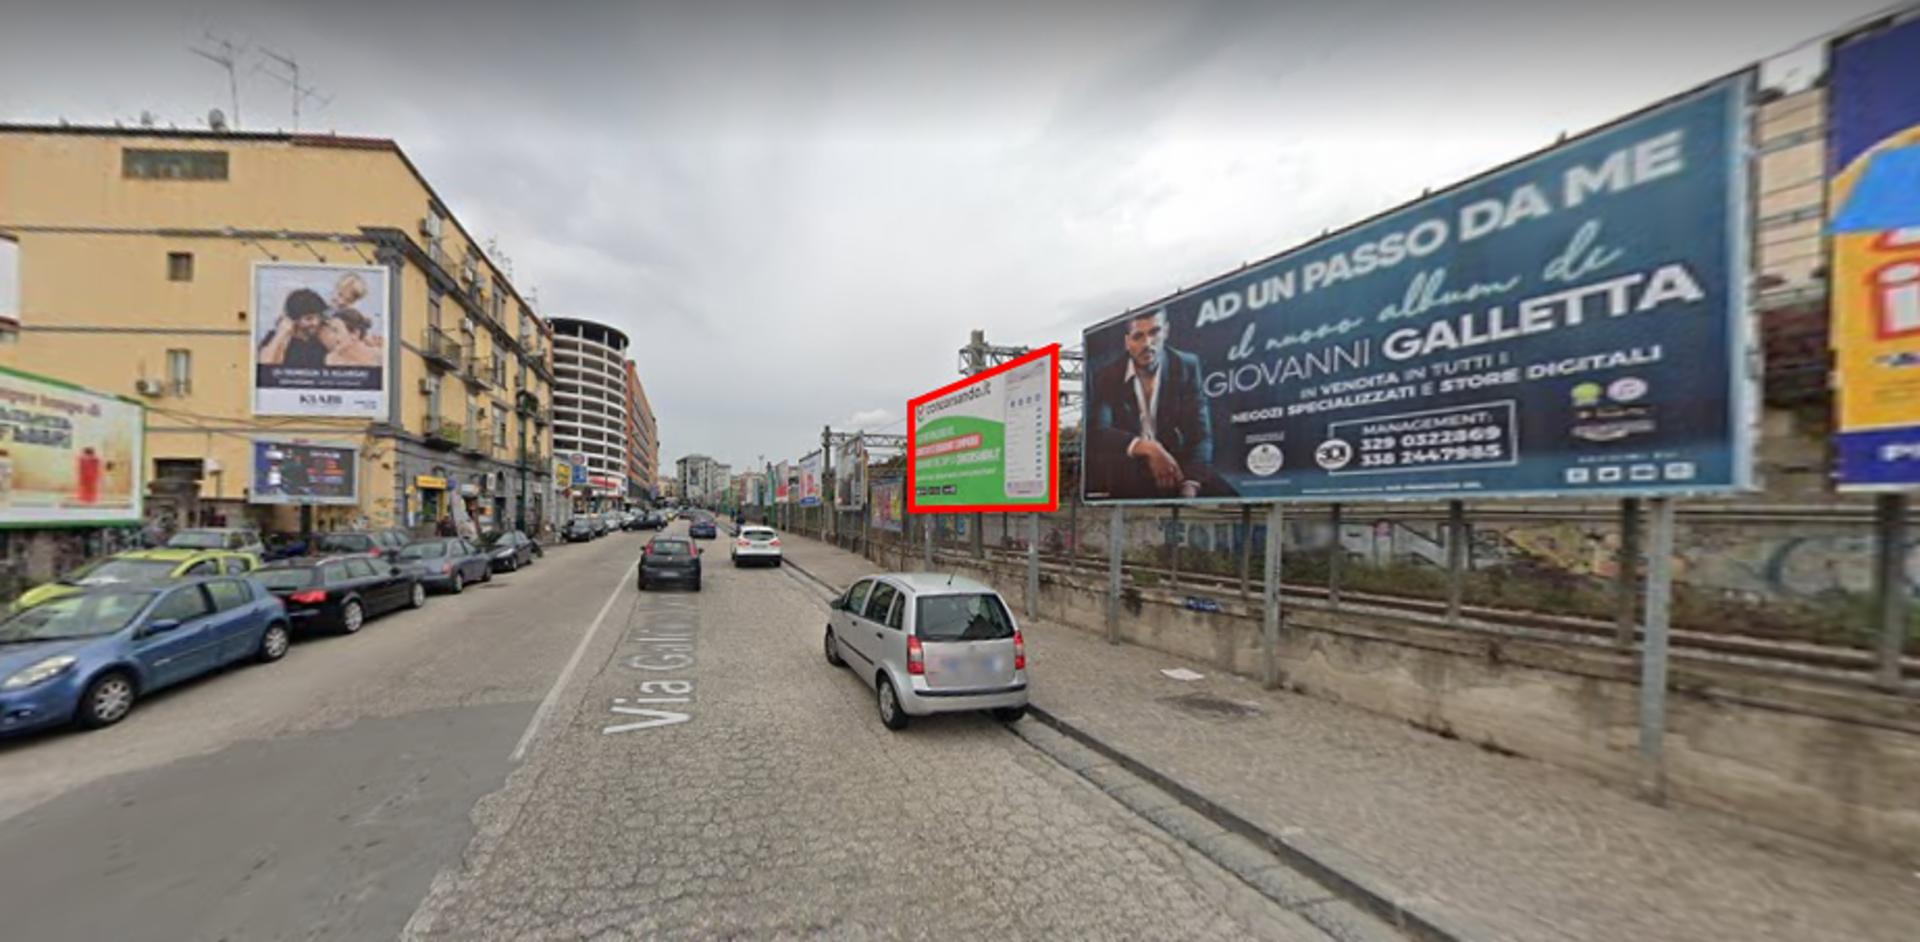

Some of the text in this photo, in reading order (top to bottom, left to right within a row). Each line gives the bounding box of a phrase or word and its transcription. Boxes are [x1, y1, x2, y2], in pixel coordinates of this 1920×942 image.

[1195, 129, 1684, 328] AD UN PASSO DA ME
[1227, 218, 1625, 361] il nuovo album di
[1203, 263, 1705, 397] GIOVANNI GALLETTA
[1231, 344, 1662, 423] NEGOZI SPECIALIZZATI E STORE DIGITALI
[1301, 386, 1318, 399] IN
[1320, 372, 1399, 394] VENDITA
[1404, 365, 1427, 381] IN
[1430, 354, 1492, 376] TUTTI
[1360, 436, 1396, 451] 329
[1362, 411, 1493, 435] MANAGEMENT:
[1360, 452, 1396, 467] 338
